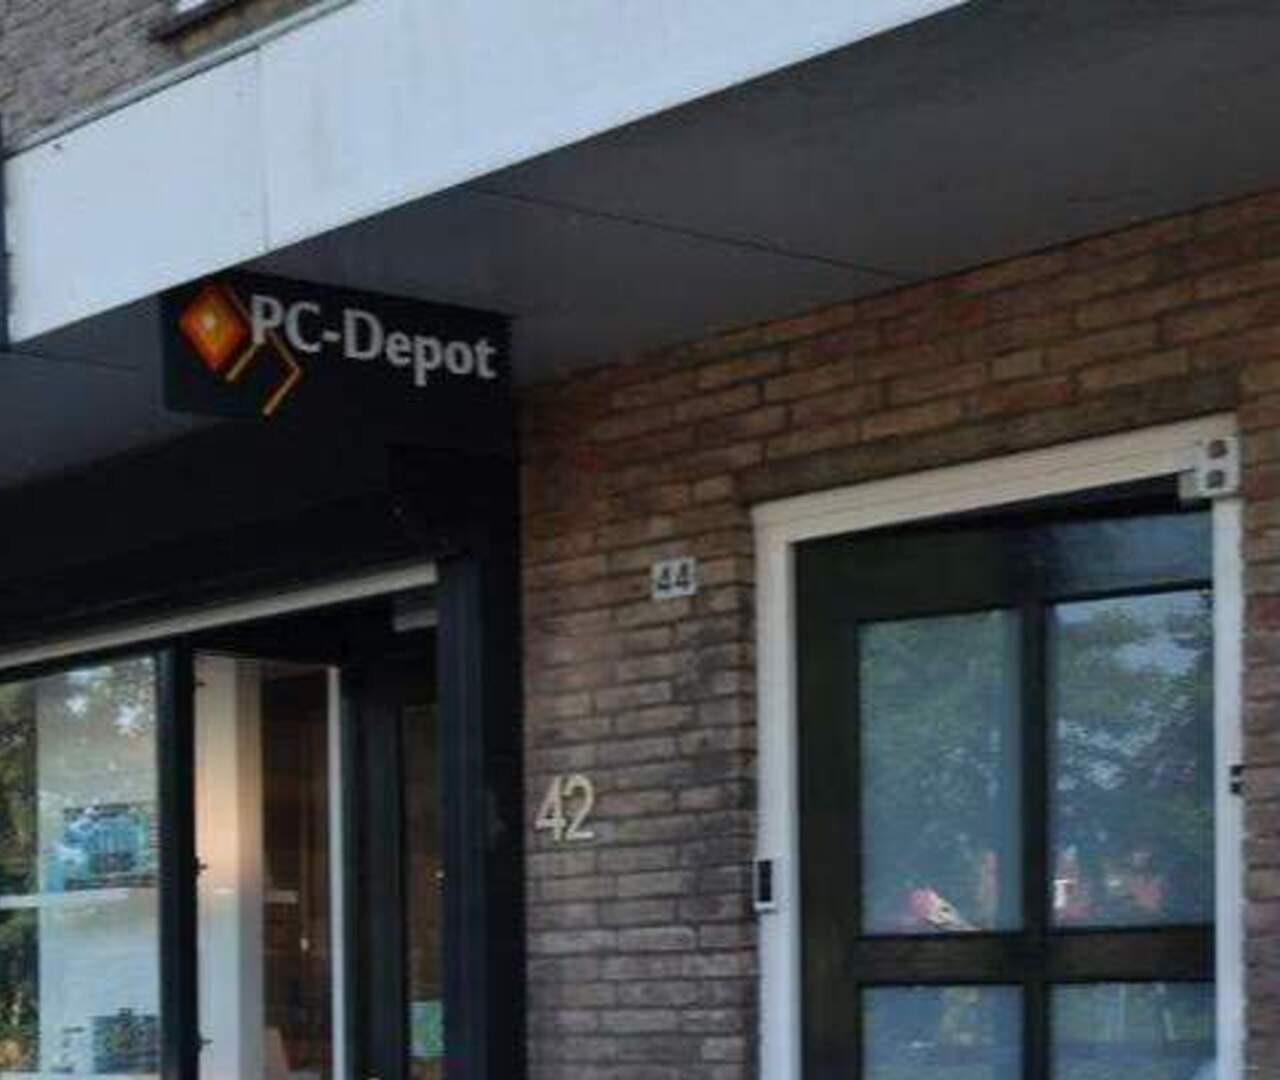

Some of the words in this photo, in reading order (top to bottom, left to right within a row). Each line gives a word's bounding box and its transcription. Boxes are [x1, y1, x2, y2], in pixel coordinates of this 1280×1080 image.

[250, 293, 498, 387] PC-Depot
[656, 560, 692, 591] 44
[535, 772, 596, 842] 42
